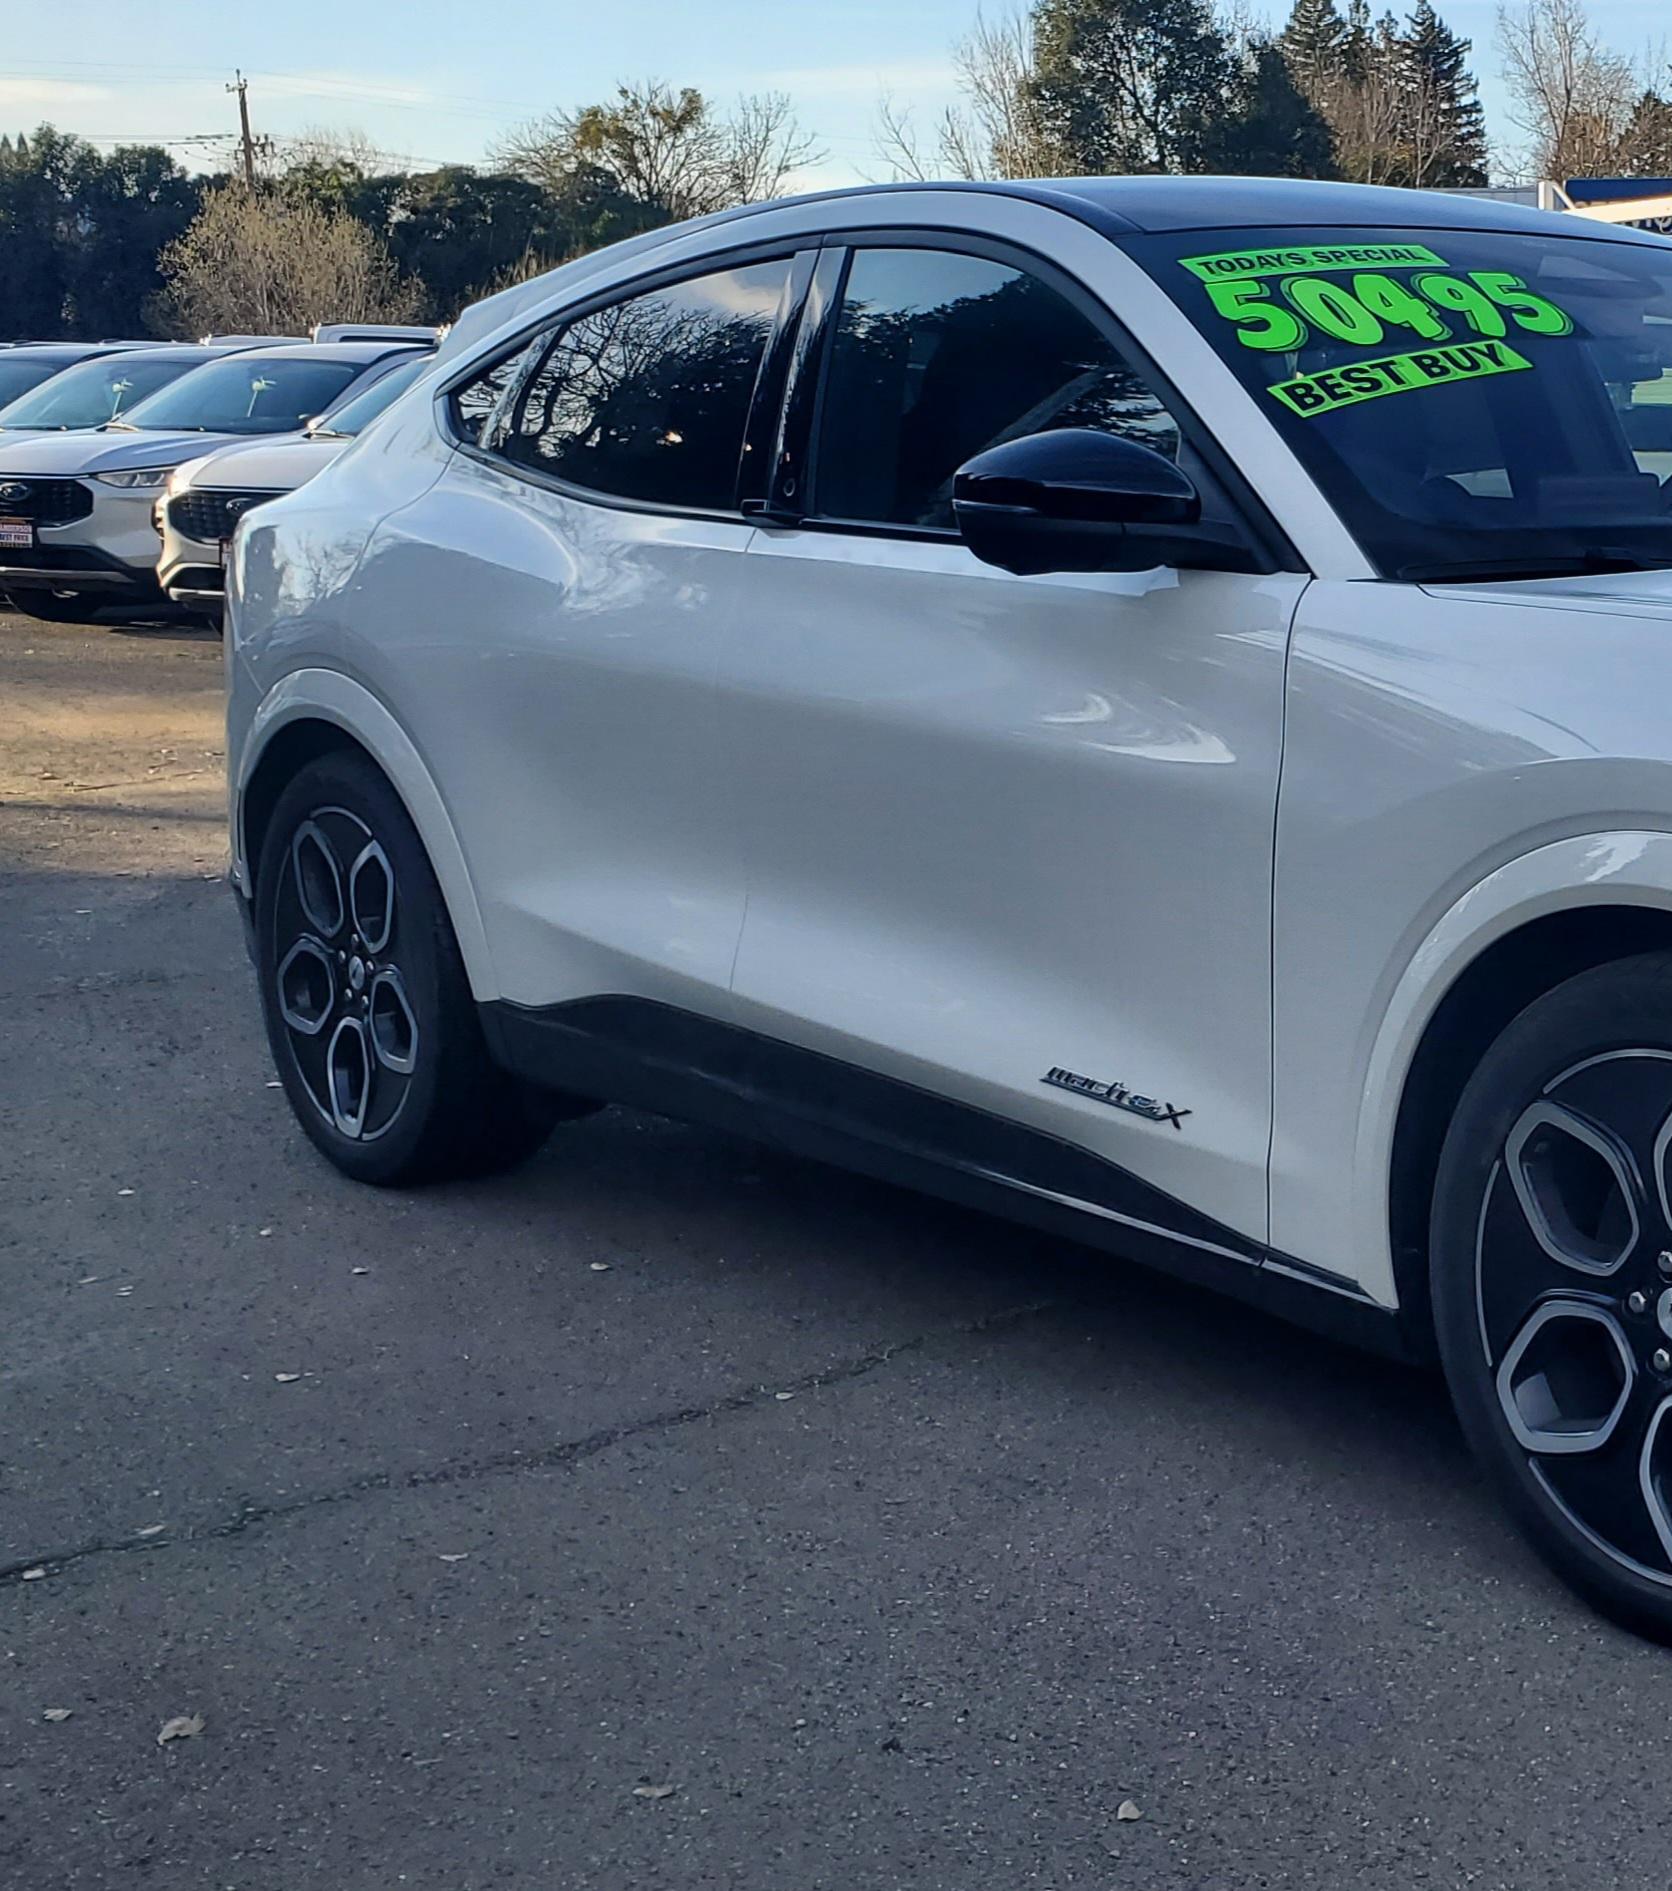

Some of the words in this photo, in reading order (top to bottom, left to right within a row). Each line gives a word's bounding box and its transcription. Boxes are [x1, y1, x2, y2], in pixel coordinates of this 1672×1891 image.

[1197, 252, 1308, 276] TODAYS
[1311, 248, 1427, 264] SPECIAL
[1204, 272, 1573, 351] 50495
[1280, 359, 1407, 411] BEST
[1407, 343, 1506, 379] BUY
